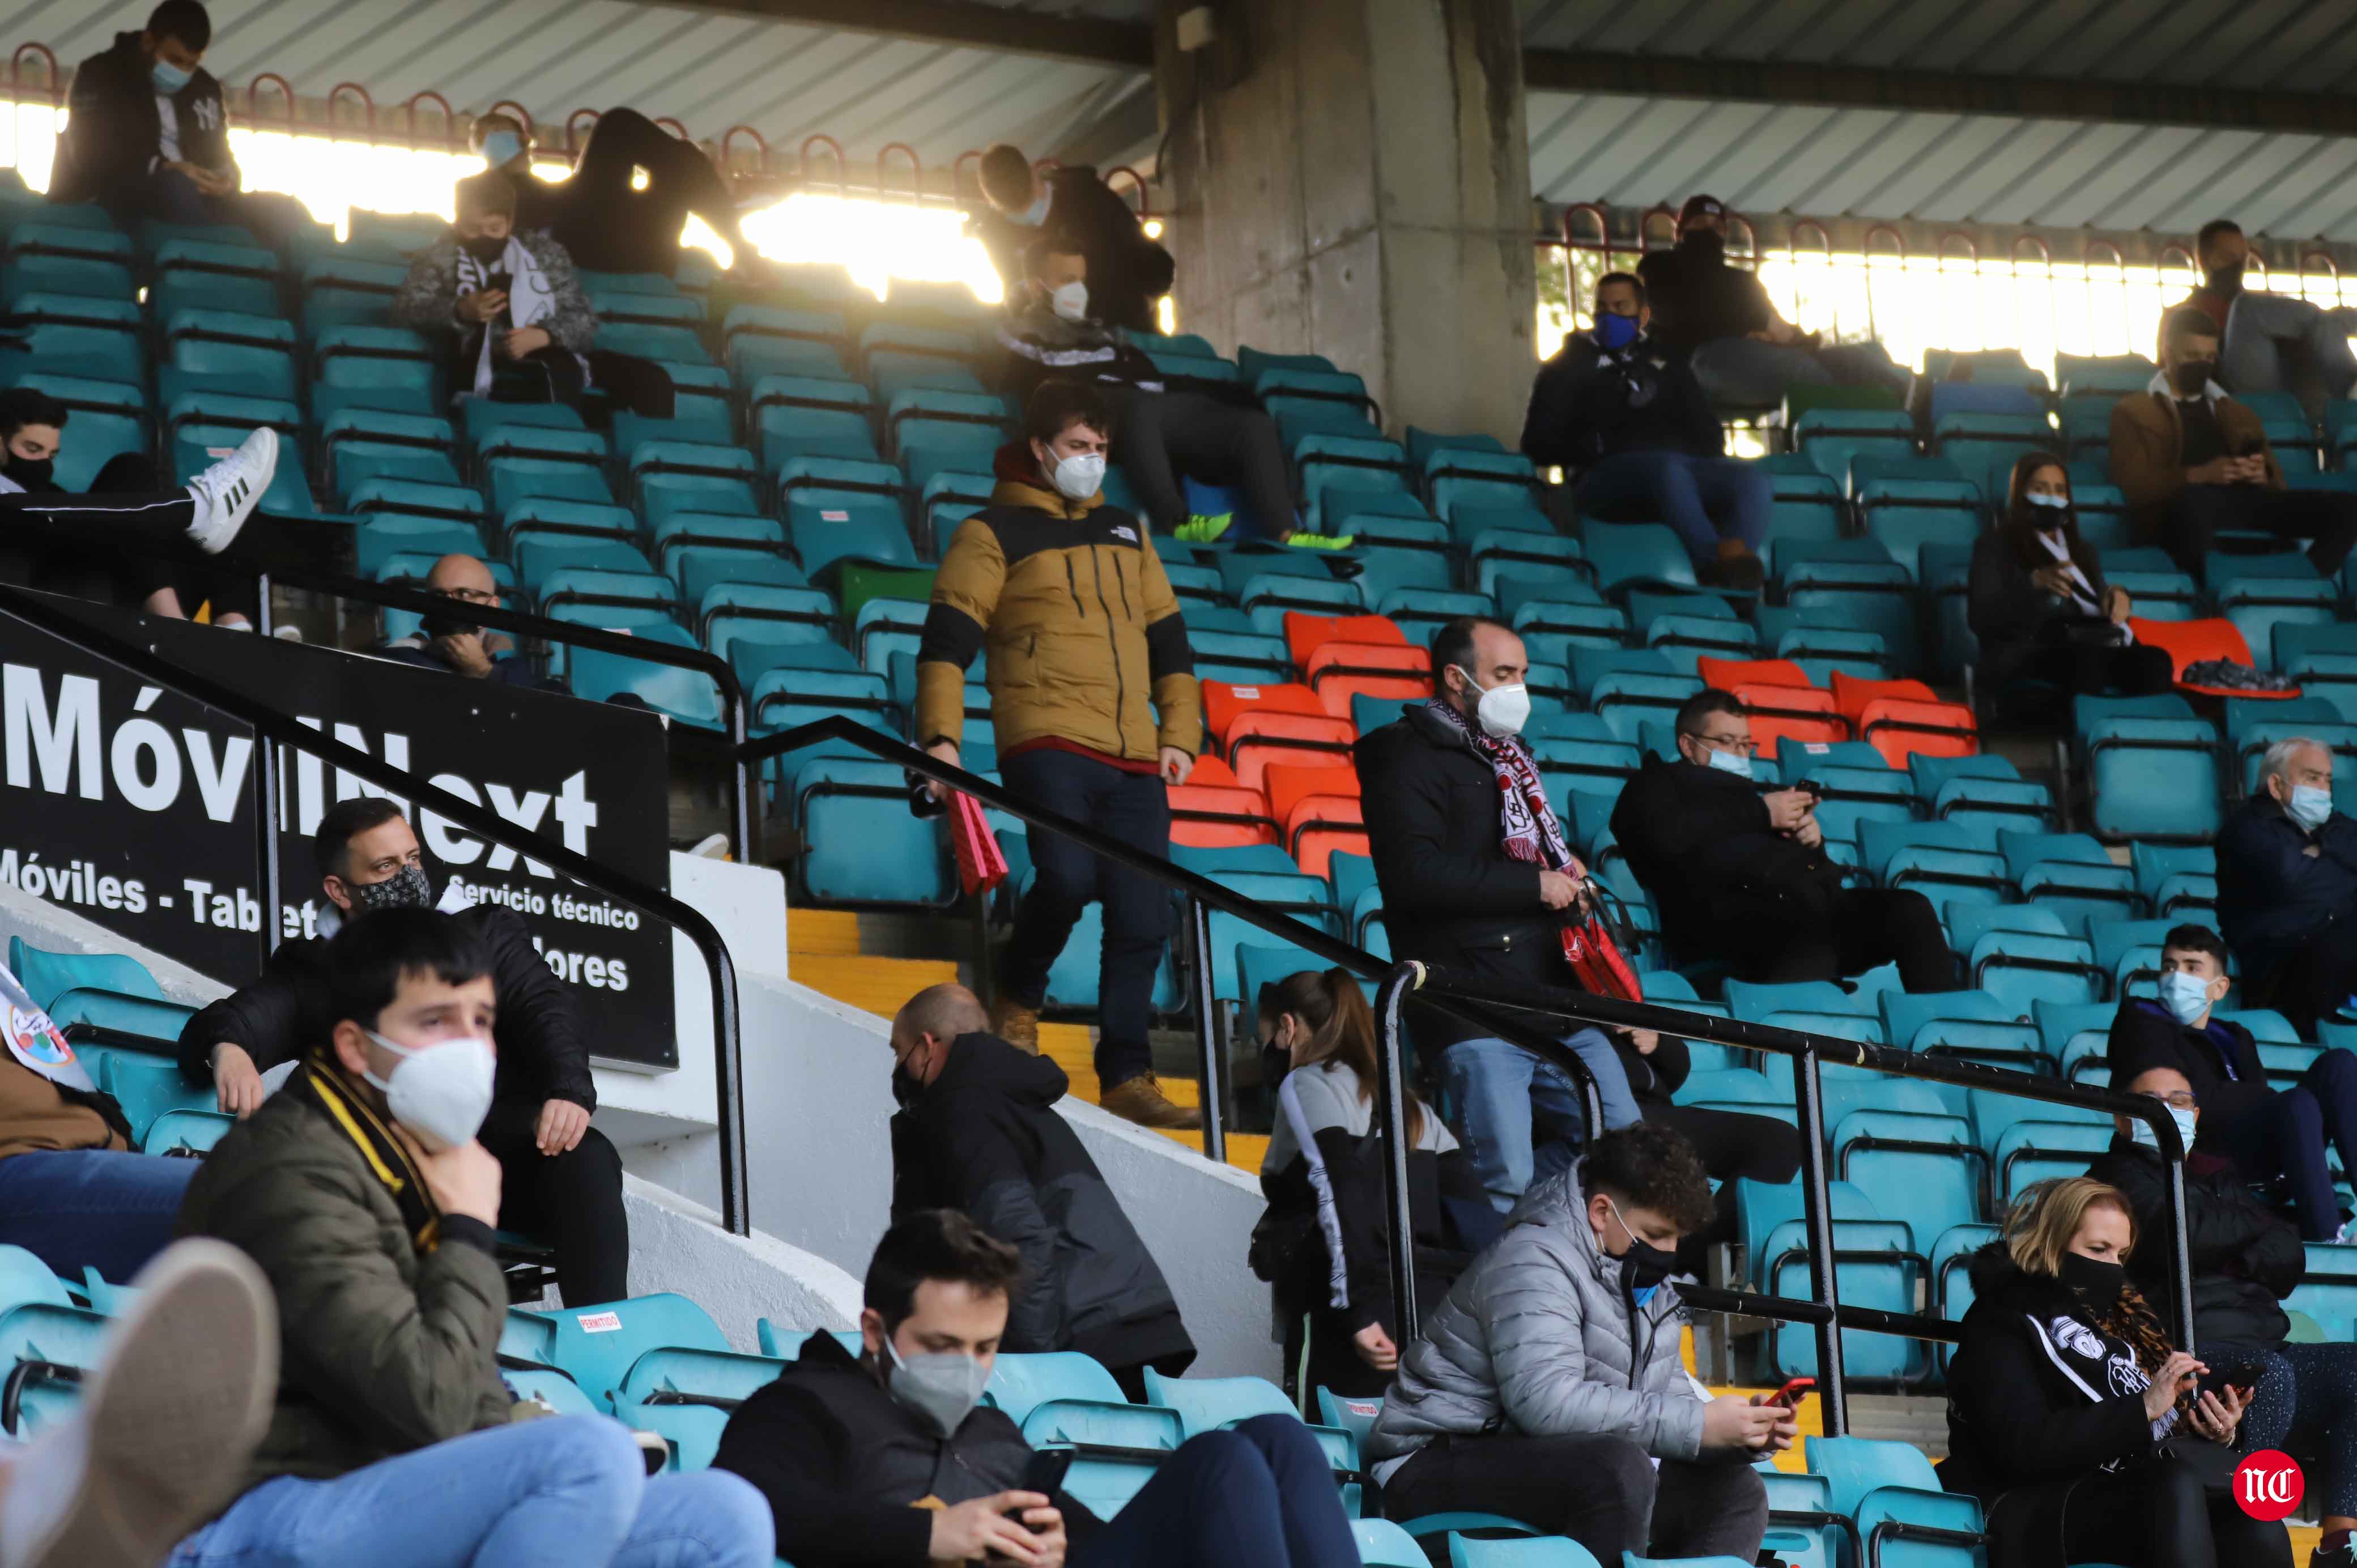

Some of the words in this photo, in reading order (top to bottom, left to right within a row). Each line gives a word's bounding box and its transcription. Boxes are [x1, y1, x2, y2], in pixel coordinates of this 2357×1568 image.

[183, 879, 317, 940] Tabet
[449, 875, 544, 915] Servicio
[551, 893, 638, 931] técnico
